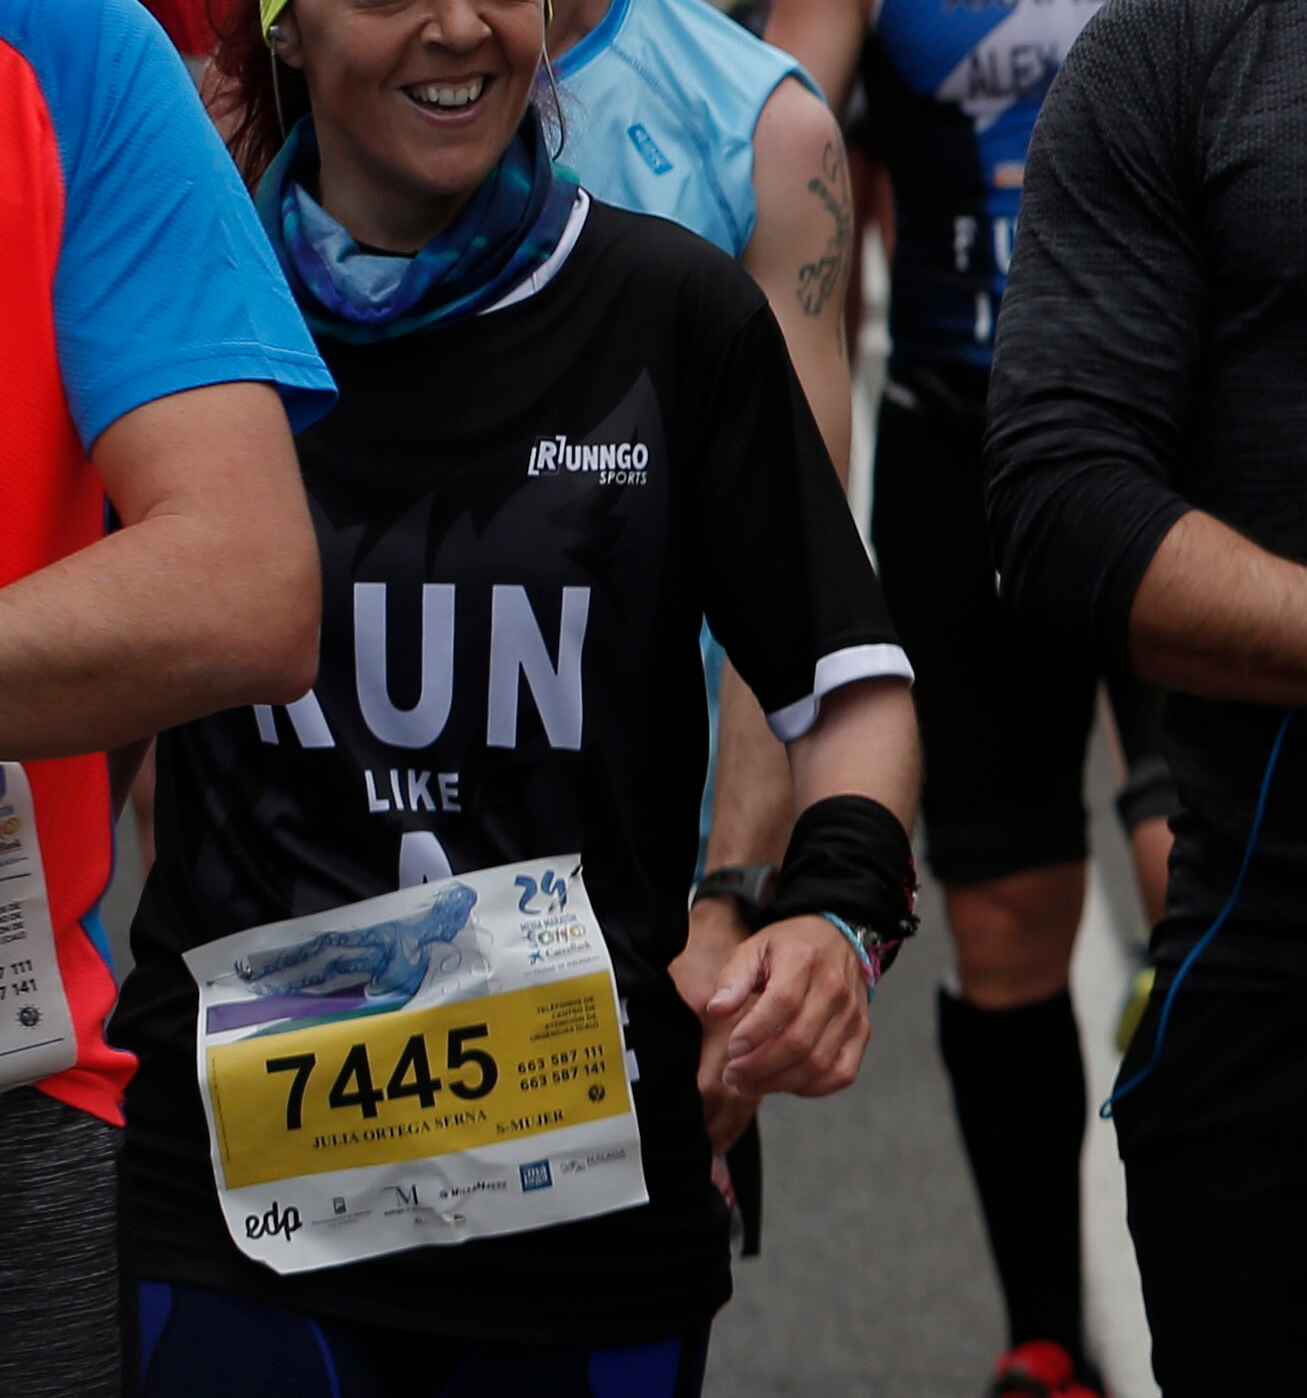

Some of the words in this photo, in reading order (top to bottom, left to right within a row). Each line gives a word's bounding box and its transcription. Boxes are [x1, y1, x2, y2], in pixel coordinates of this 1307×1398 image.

[599, 471, 648, 485] SPORTS
[364, 768, 462, 813] LIKE
[514, 869, 568, 915] 29
[10, 959, 33, 975] 111
[12, 978, 37, 996] 141
[265, 1022, 498, 1131] 7445
[517, 1057, 546, 1074] 663
[551, 1049, 578, 1065] 587
[584, 1044, 604, 1060] 111
[520, 1074, 548, 1091] 663
[552, 1067, 578, 1083] 587
[584, 1061, 606, 1076] 141
[313, 1131, 360, 1150] JULIA
[363, 1121, 432, 1141] ORTEGA
[436, 1109, 487, 1129] SERNA
[496, 1110, 565, 1136] S-MUJER
[244, 1200, 303, 1242] edp
